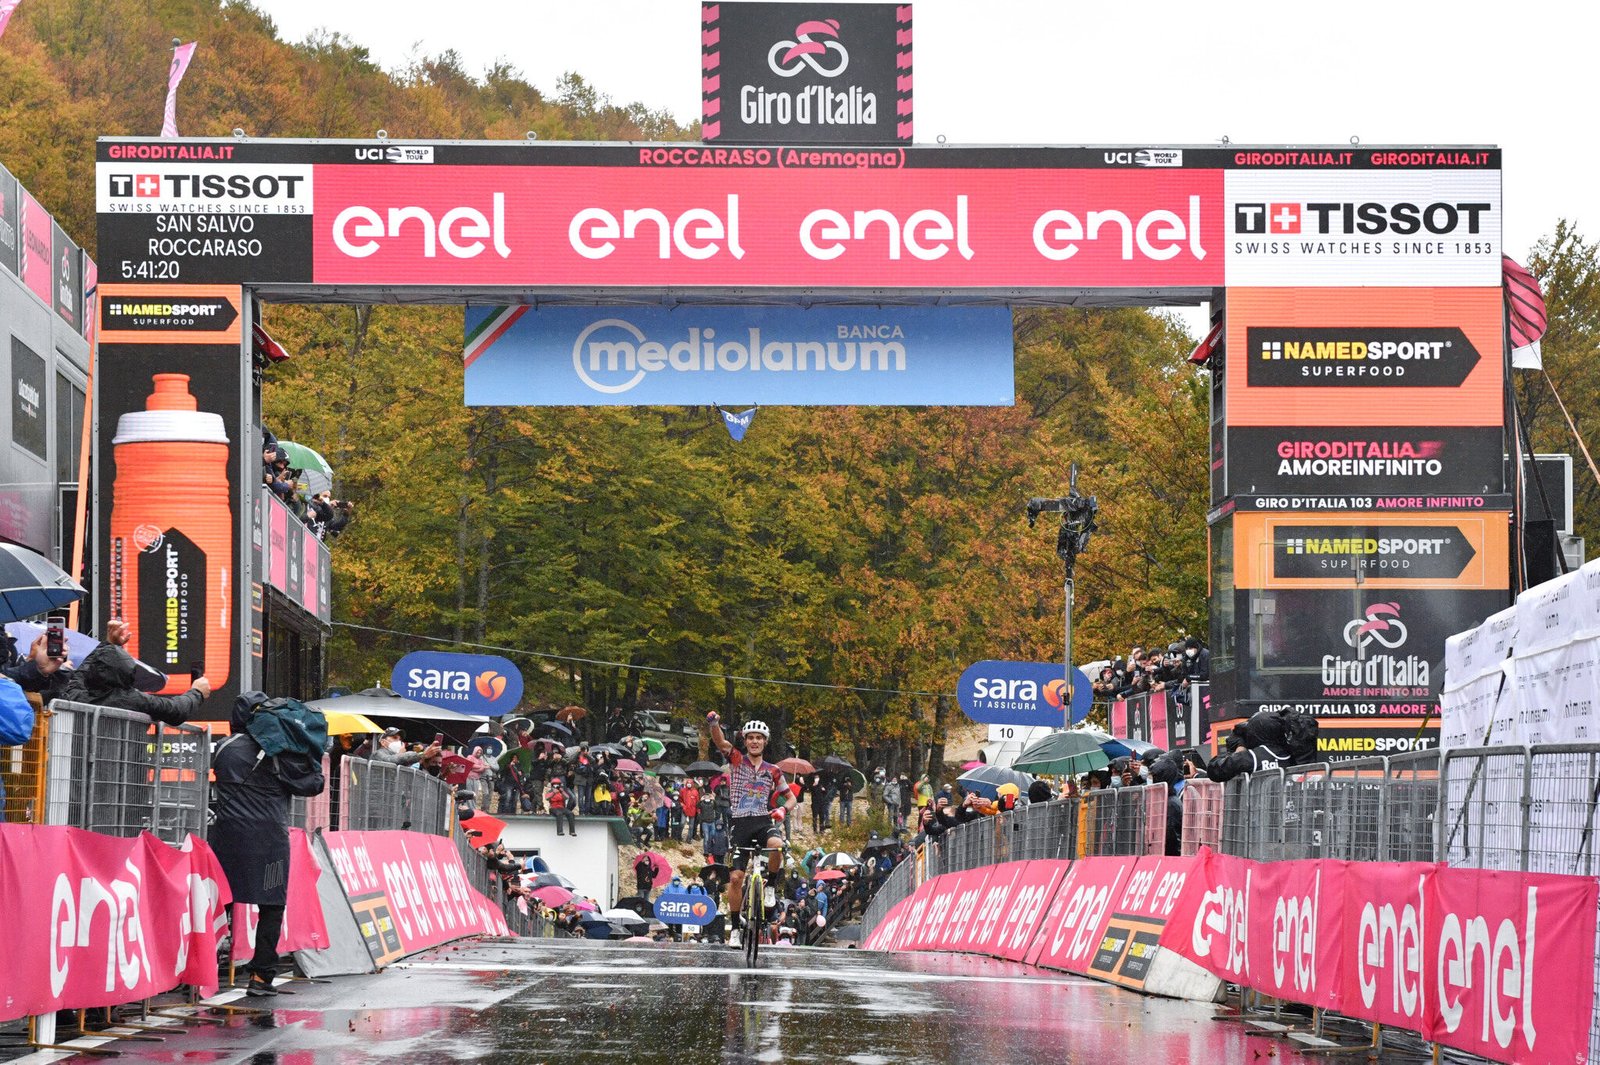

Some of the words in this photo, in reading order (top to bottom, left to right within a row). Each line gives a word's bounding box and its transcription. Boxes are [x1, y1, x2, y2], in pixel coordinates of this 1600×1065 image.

[740, 85, 792, 124] Giro
[797, 85, 877, 124] d'Italia
[109, 146, 234, 160] GIRODITALIA.IT
[355, 148, 384, 160] UCI
[639, 149, 771, 166] ROCCARASO
[776, 148, 906, 169] (Aremogna)
[1104, 153, 1132, 164] UCI
[1234, 153, 1354, 165] GIRODITALIA.IT
[1370, 153, 1490, 165] GIRODITALIA.IT
[164, 175, 304, 198] TISSOT
[109, 204, 152, 213] SWISS
[160, 204, 222, 213] WATCHES
[230, 204, 269, 213] SINCE
[276, 205, 305, 214] 1853
[156, 216, 193, 232] SAN
[196, 216, 254, 233] SALVO
[333, 192, 512, 258] enel
[568, 194, 746, 260] enel
[1306, 203, 1491, 234] TISSOT
[800, 195, 974, 260] enel
[1033, 195, 1207, 261] enel
[148, 239, 262, 256] ROCCARASO
[1234, 242, 1290, 254] SWISS
[1300, 242, 1382, 254] WATCHES
[1393, 242, 1444, 254] SINCE
[1455, 242, 1492, 254] 1853
[121, 260, 180, 279] 5:41:20
[133, 318, 194, 326] SUPERFOOD
[836, 325, 904, 339] BANCA
[588, 328, 906, 372] mediolanum
[1301, 365, 1406, 376] SUPERFOOD
[726, 413, 749, 426] GPM
[1278, 441, 1414, 458] GIRODITALIA
[1278, 459, 1442, 476] AMOREINFINITO
[1255, 498, 1288, 508] GIRO
[1292, 498, 1348, 508] D'ITALIA
[1351, 498, 1372, 508] 103
[1376, 498, 1423, 508] AMORE
[1426, 497, 1484, 508] INFINITO
[1321, 560, 1410, 568] SUPRFOOD
[1322, 654, 1362, 686] Giro
[1365, 655, 1430, 686] d'Italia
[408, 668, 470, 692] sara
[422, 692, 469, 700] ASSICURA
[973, 678, 1037, 700] sara
[1322, 688, 1360, 696] AMORE
[1363, 688, 1409, 696] INFINITO
[1412, 688, 1429, 696] 103
[973, 700, 984, 708] TI
[987, 701, 1037, 711] ASSICURA
[1354, 704, 1376, 714] 103
[1380, 704, 1426, 714] AMORE
[1000, 728, 1014, 739] 10
[1262, 760, 1279, 770] Rai
[382, 840, 434, 941] enel
[1150, 872, 1186, 916] ene
[660, 901, 690, 913] sara
[998, 867, 1060, 950] enel
[1050, 864, 1125, 961] enel
[50, 857, 152, 998] enel
[1273, 869, 1320, 992] enel
[1358, 874, 1425, 1018] enel
[1438, 886, 1538, 1052] enel
